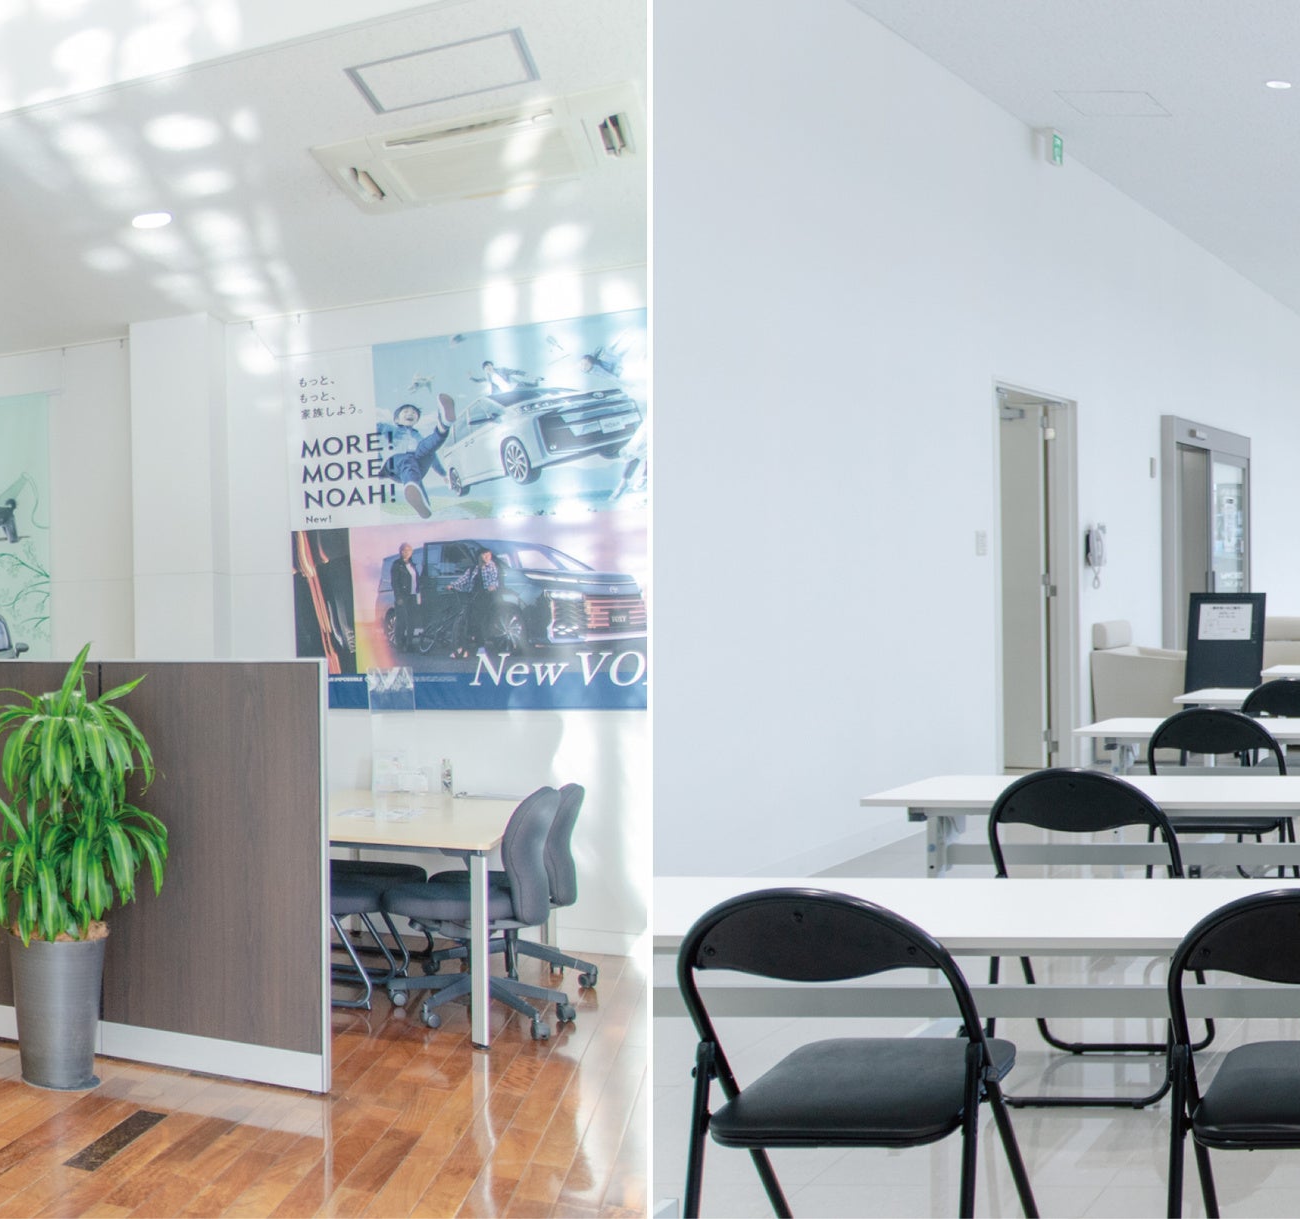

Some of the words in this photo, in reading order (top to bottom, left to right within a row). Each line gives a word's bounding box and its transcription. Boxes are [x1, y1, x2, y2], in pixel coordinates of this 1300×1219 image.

[301, 431, 394, 458] MORE!
[302, 457, 395, 484] MORE!
[304, 483, 397, 509] NOAH!
[305, 515, 332, 524] New!
[469, 651, 569, 687] New
[574, 651, 647, 687] VO
